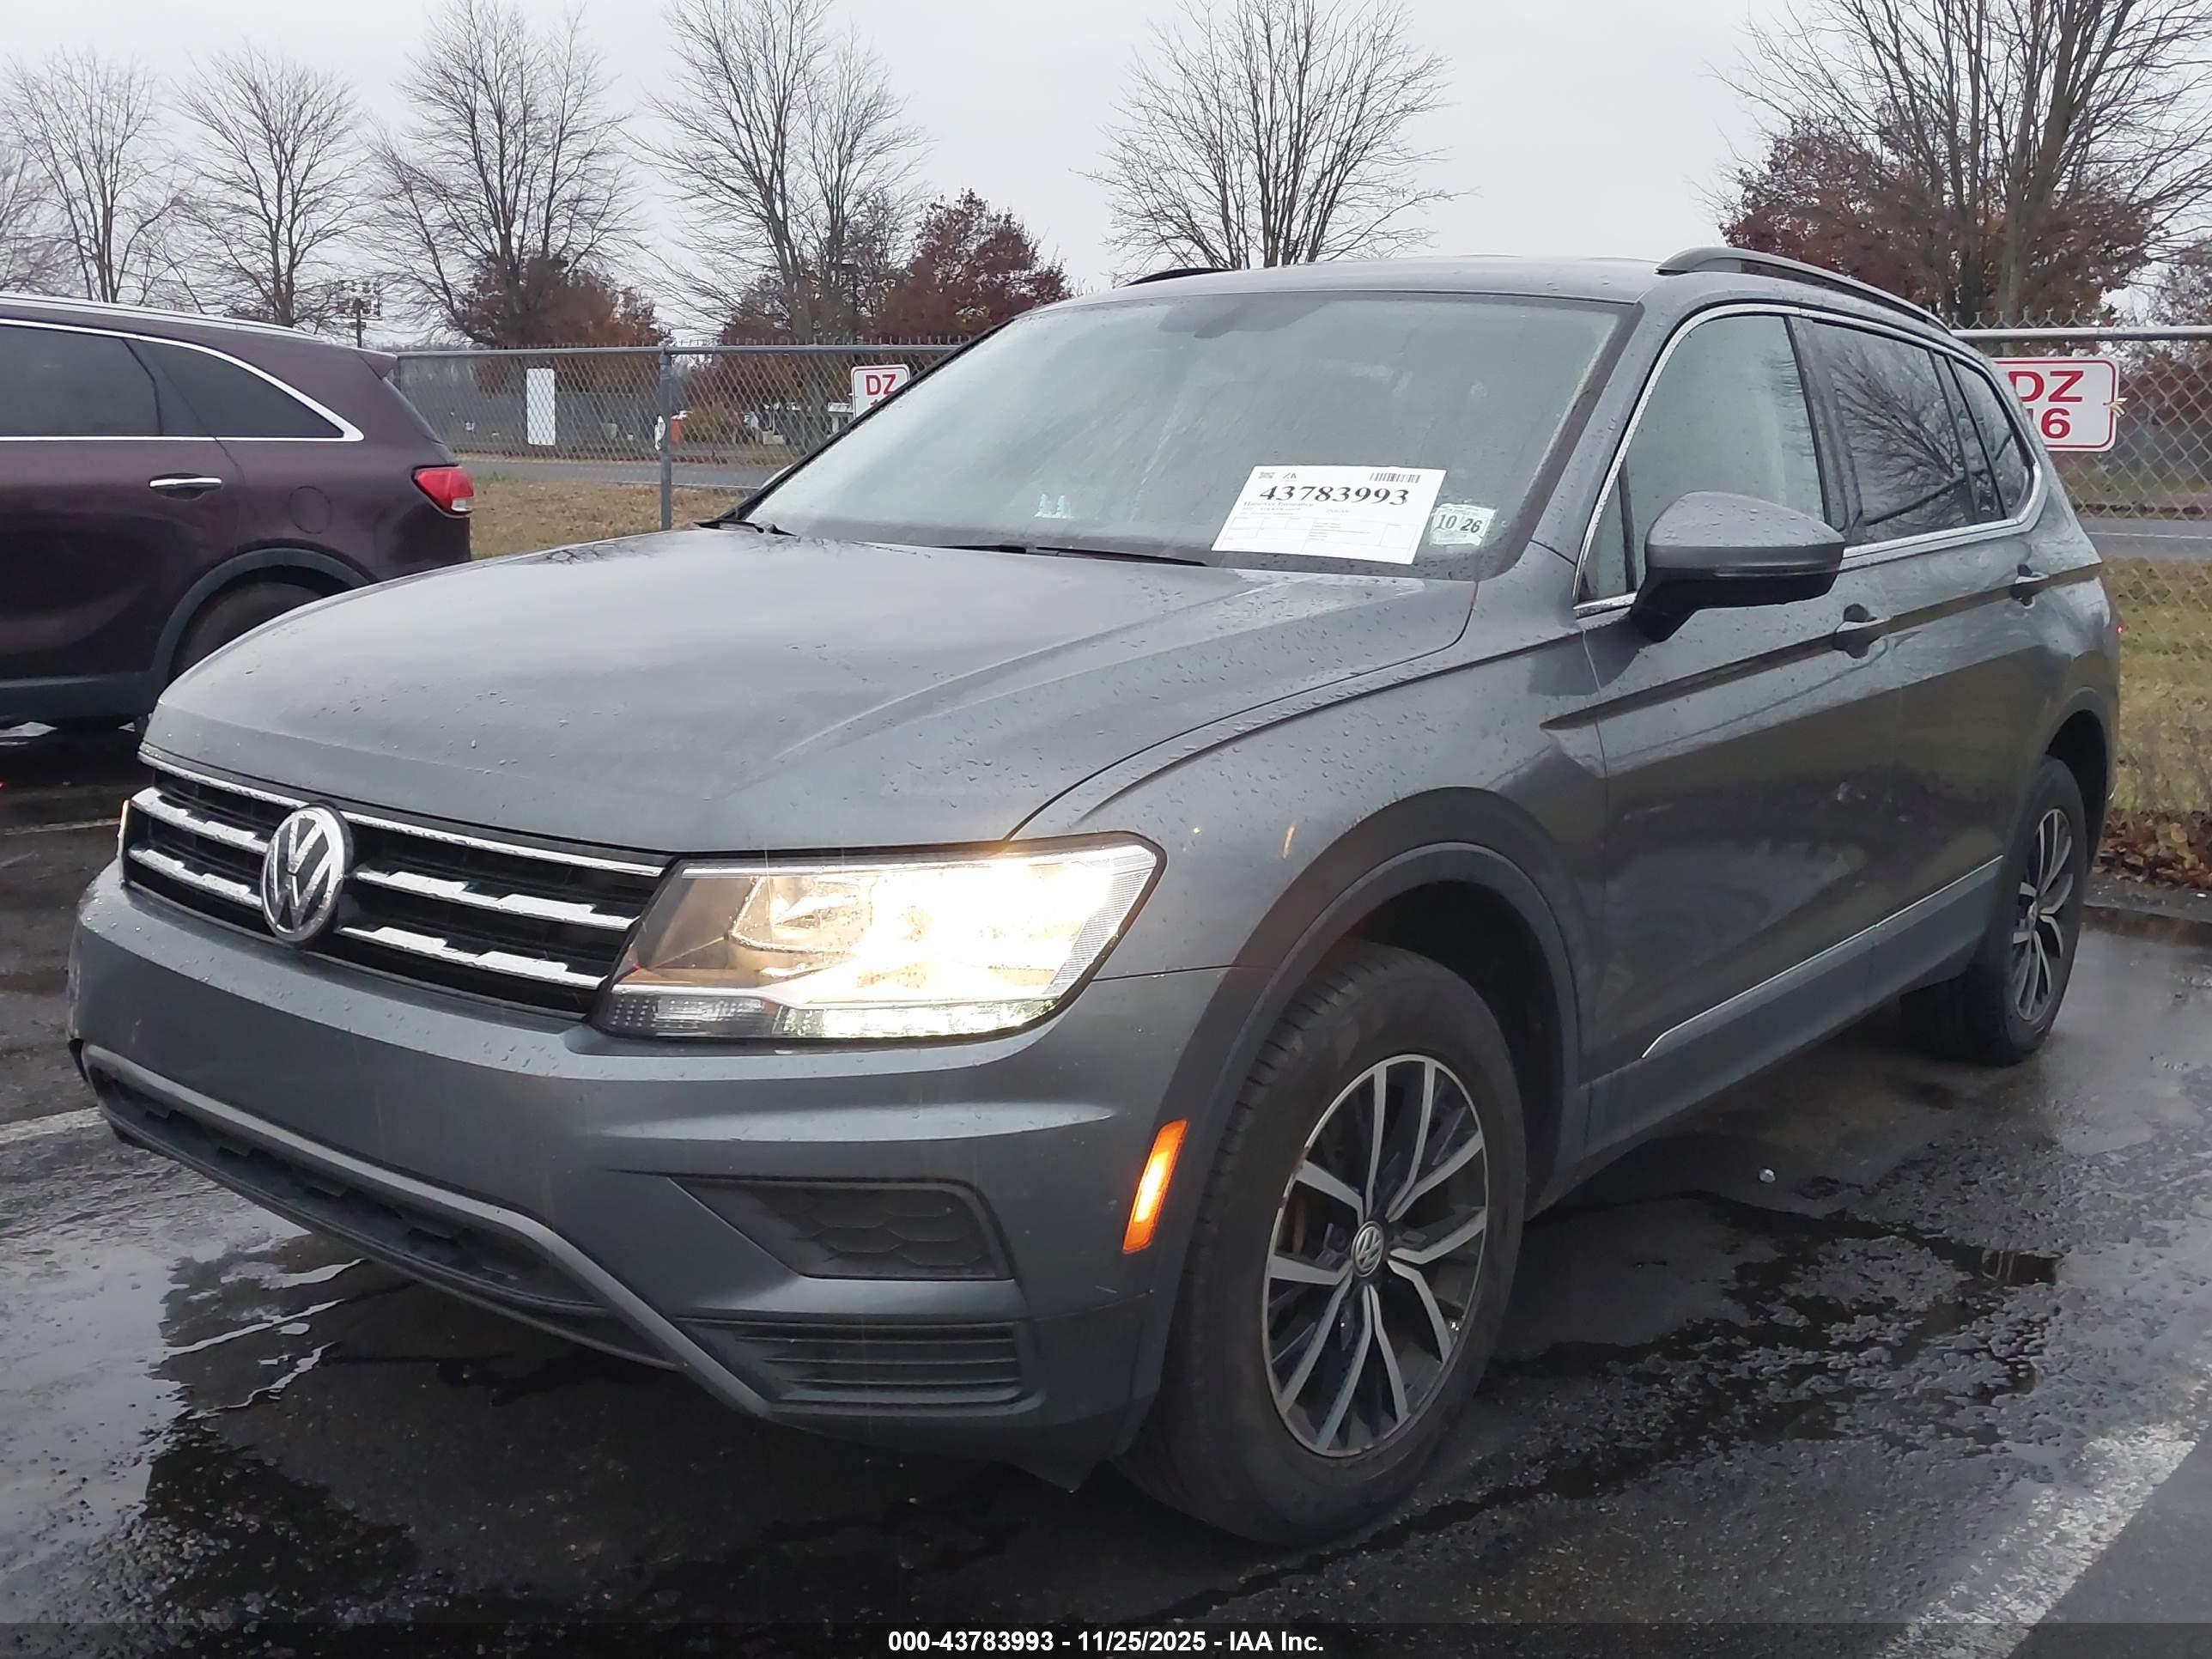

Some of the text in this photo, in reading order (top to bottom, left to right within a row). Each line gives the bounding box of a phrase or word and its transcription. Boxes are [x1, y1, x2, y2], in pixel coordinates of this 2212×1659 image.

[865, 374, 896, 396] DZ
[2008, 370, 2085, 403] DZ
[1258, 484, 1410, 506] 43783993
[1433, 514, 1484, 533] 10 26
